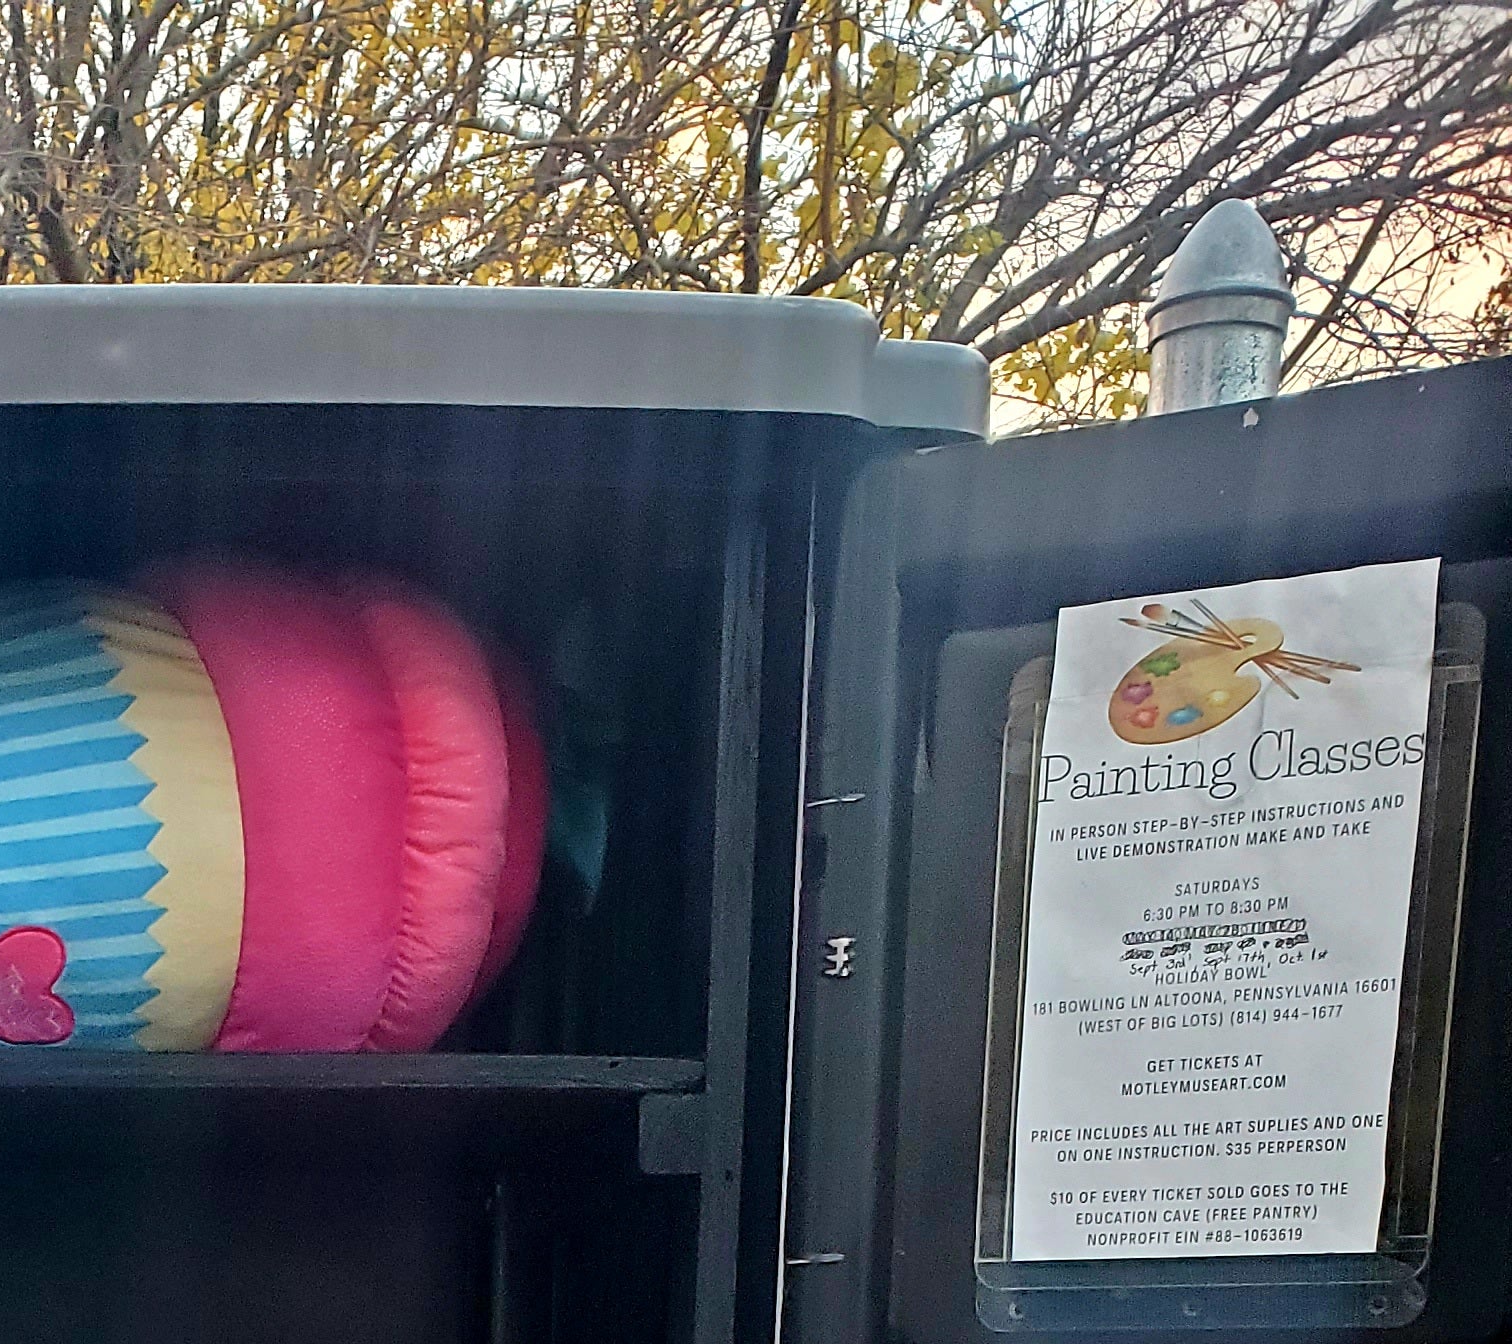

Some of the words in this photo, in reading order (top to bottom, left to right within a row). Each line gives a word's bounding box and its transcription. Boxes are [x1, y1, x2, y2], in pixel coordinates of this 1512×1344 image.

[1038, 752, 1238, 803] Painting
[1249, 728, 1426, 781] Classes
[1050, 828, 1065, 842] IN
[1071, 822, 1127, 841] PERSON
[1133, 811, 1246, 834] STEP-BY-STEP
[1251, 799, 1365, 823] INSTRUCTIONS
[1371, 794, 1405, 810] AND
[1077, 846, 1108, 861] LIVE
[1113, 834, 1239, 858] DEMONSTRATION
[1246, 829, 1287, 846] MAKE
[1293, 825, 1326, 840] AND
[1332, 821, 1371, 837] TAKE
[1175, 877, 1260, 897] SATURDAYS
[1143, 906, 1173, 922] 6:30
[1179, 903, 1200, 918] PM
[1206, 901, 1225, 916] TO
[1230, 899, 1262, 914] 8:30
[1267, 896, 1289, 911] PM
[1155, 969, 1219, 987] HOLIDAY
[1224, 967, 1268, 981] BOWL
[1033, 1002, 1053, 1016] 181
[1059, 997, 1125, 1014] BOWLING
[1131, 996, 1149, 1009] LN
[1154, 990, 1227, 1007] ALTOONA,
[1233, 981, 1349, 1001] PENNSYLVANIA
[1355, 978, 1396, 994] 16601
[1079, 1019, 1122, 1036] (WEST
[1127, 1018, 1146, 1031] OF
[1151, 1016, 1176, 1029] BIG
[1182, 1012, 1224, 1028] LOTS)
[1230, 1009, 1267, 1027] (814)
[1273, 1004, 1343, 1022] 944-1677
[1147, 1059, 1175, 1073] GET
[1180, 1055, 1239, 1071] TICKETS
[1244, 1054, 1264, 1068] AT
[1121, 1074, 1287, 1096] MOTLEYMUSEART.COM
[1031, 1128, 1072, 1142] PRICE
[1077, 1126, 1148, 1141] INCLUDES
[1153, 1124, 1178, 1138] ALL
[1183, 1122, 1210, 1136] THE
[1215, 1121, 1242, 1135] ART
[1248, 1117, 1308, 1133] SUPLIES
[1313, 1116, 1346, 1130] AND
[1352, 1114, 1384, 1128] ONE
[1057, 1150, 1077, 1162] ON
[1083, 1148, 1113, 1161] ONE
[1118, 1143, 1220, 1160] INSTRUCTION.
[1225, 1142, 1252, 1156] $35
[1257, 1138, 1346, 1154] PERPERSON
[1050, 1191, 1073, 1206] $10
[1079, 1191, 1097, 1204] OF
[1102, 1189, 1147, 1203] EVERY
[1152, 1187, 1202, 1201] TICKET
[1207, 1185, 1244, 1199] SOLD
[1250, 1184, 1289, 1198] GOES
[1295, 1183, 1314, 1196] TO
[1320, 1182, 1349, 1196] THE
[1076, 1210, 1157, 1225] EDUCATION
[1163, 1209, 1201, 1223] CAVE
[1205, 1207, 1247, 1223] (FREE
[1253, 1204, 1319, 1220] PANTRY)
[1087, 1231, 1170, 1246] NONPROFIT
[1175, 1230, 1199, 1244] EIN
[1205, 1227, 1303, 1243] #88-1063619
